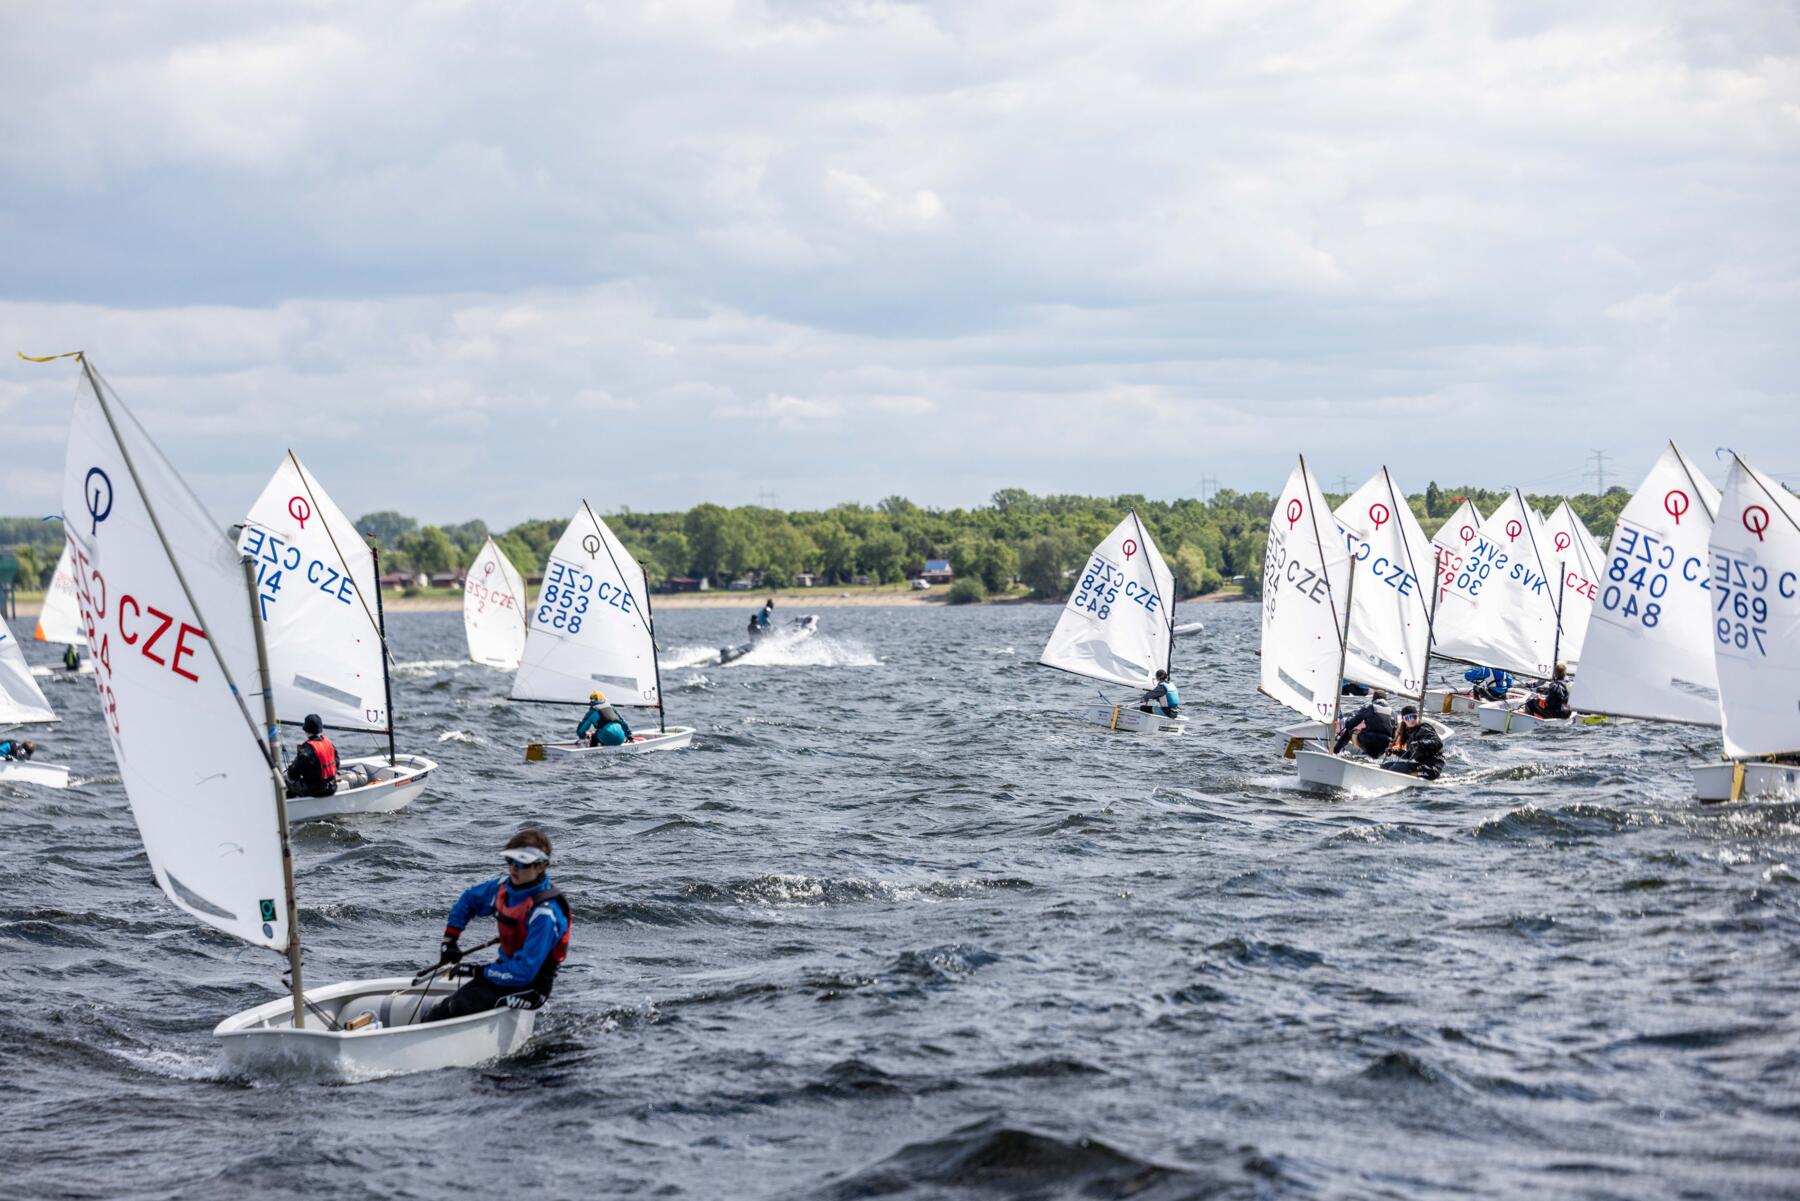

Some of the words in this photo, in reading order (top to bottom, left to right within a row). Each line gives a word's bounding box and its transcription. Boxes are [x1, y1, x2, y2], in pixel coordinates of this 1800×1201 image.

[308, 560, 354, 605] CZE
[1287, 560, 1331, 604] CZE
[1372, 558, 1417, 596] CZE
[1466, 557, 1490, 579] 30
[1510, 563, 1547, 595] SVK
[1608, 557, 1668, 598] 840
[491, 591, 515, 609] CZE
[545, 585, 589, 613] 853
[598, 582, 632, 613] CZE
[1082, 574, 1118, 603] 845
[1125, 581, 1161, 612] CZE
[1566, 572, 1598, 601] CZE
[1716, 585, 1768, 623] 769
[119, 594, 208, 682] CZE
